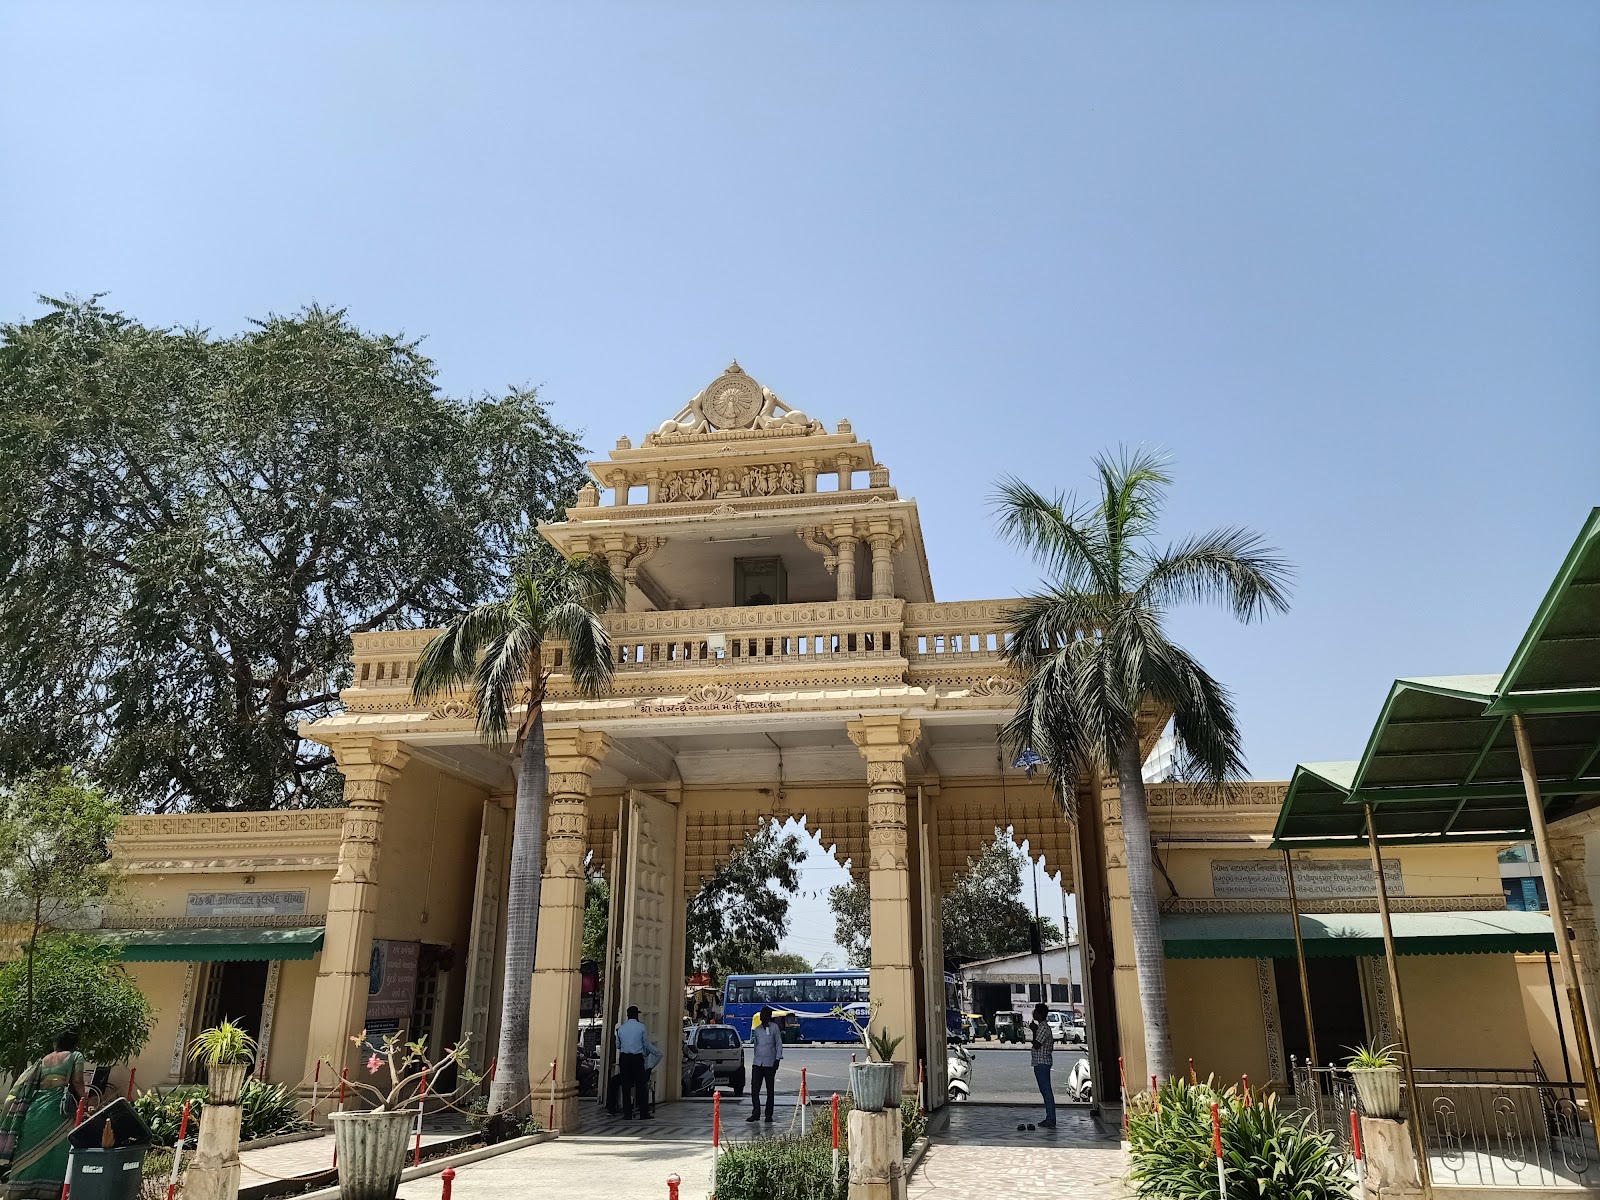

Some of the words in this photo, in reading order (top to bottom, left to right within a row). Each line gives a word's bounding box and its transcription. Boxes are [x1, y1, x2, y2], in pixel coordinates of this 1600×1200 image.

[815, 979, 826, 987] Toll
[828, 979, 841, 987] Free
[854, 978, 868, 986] 1800
